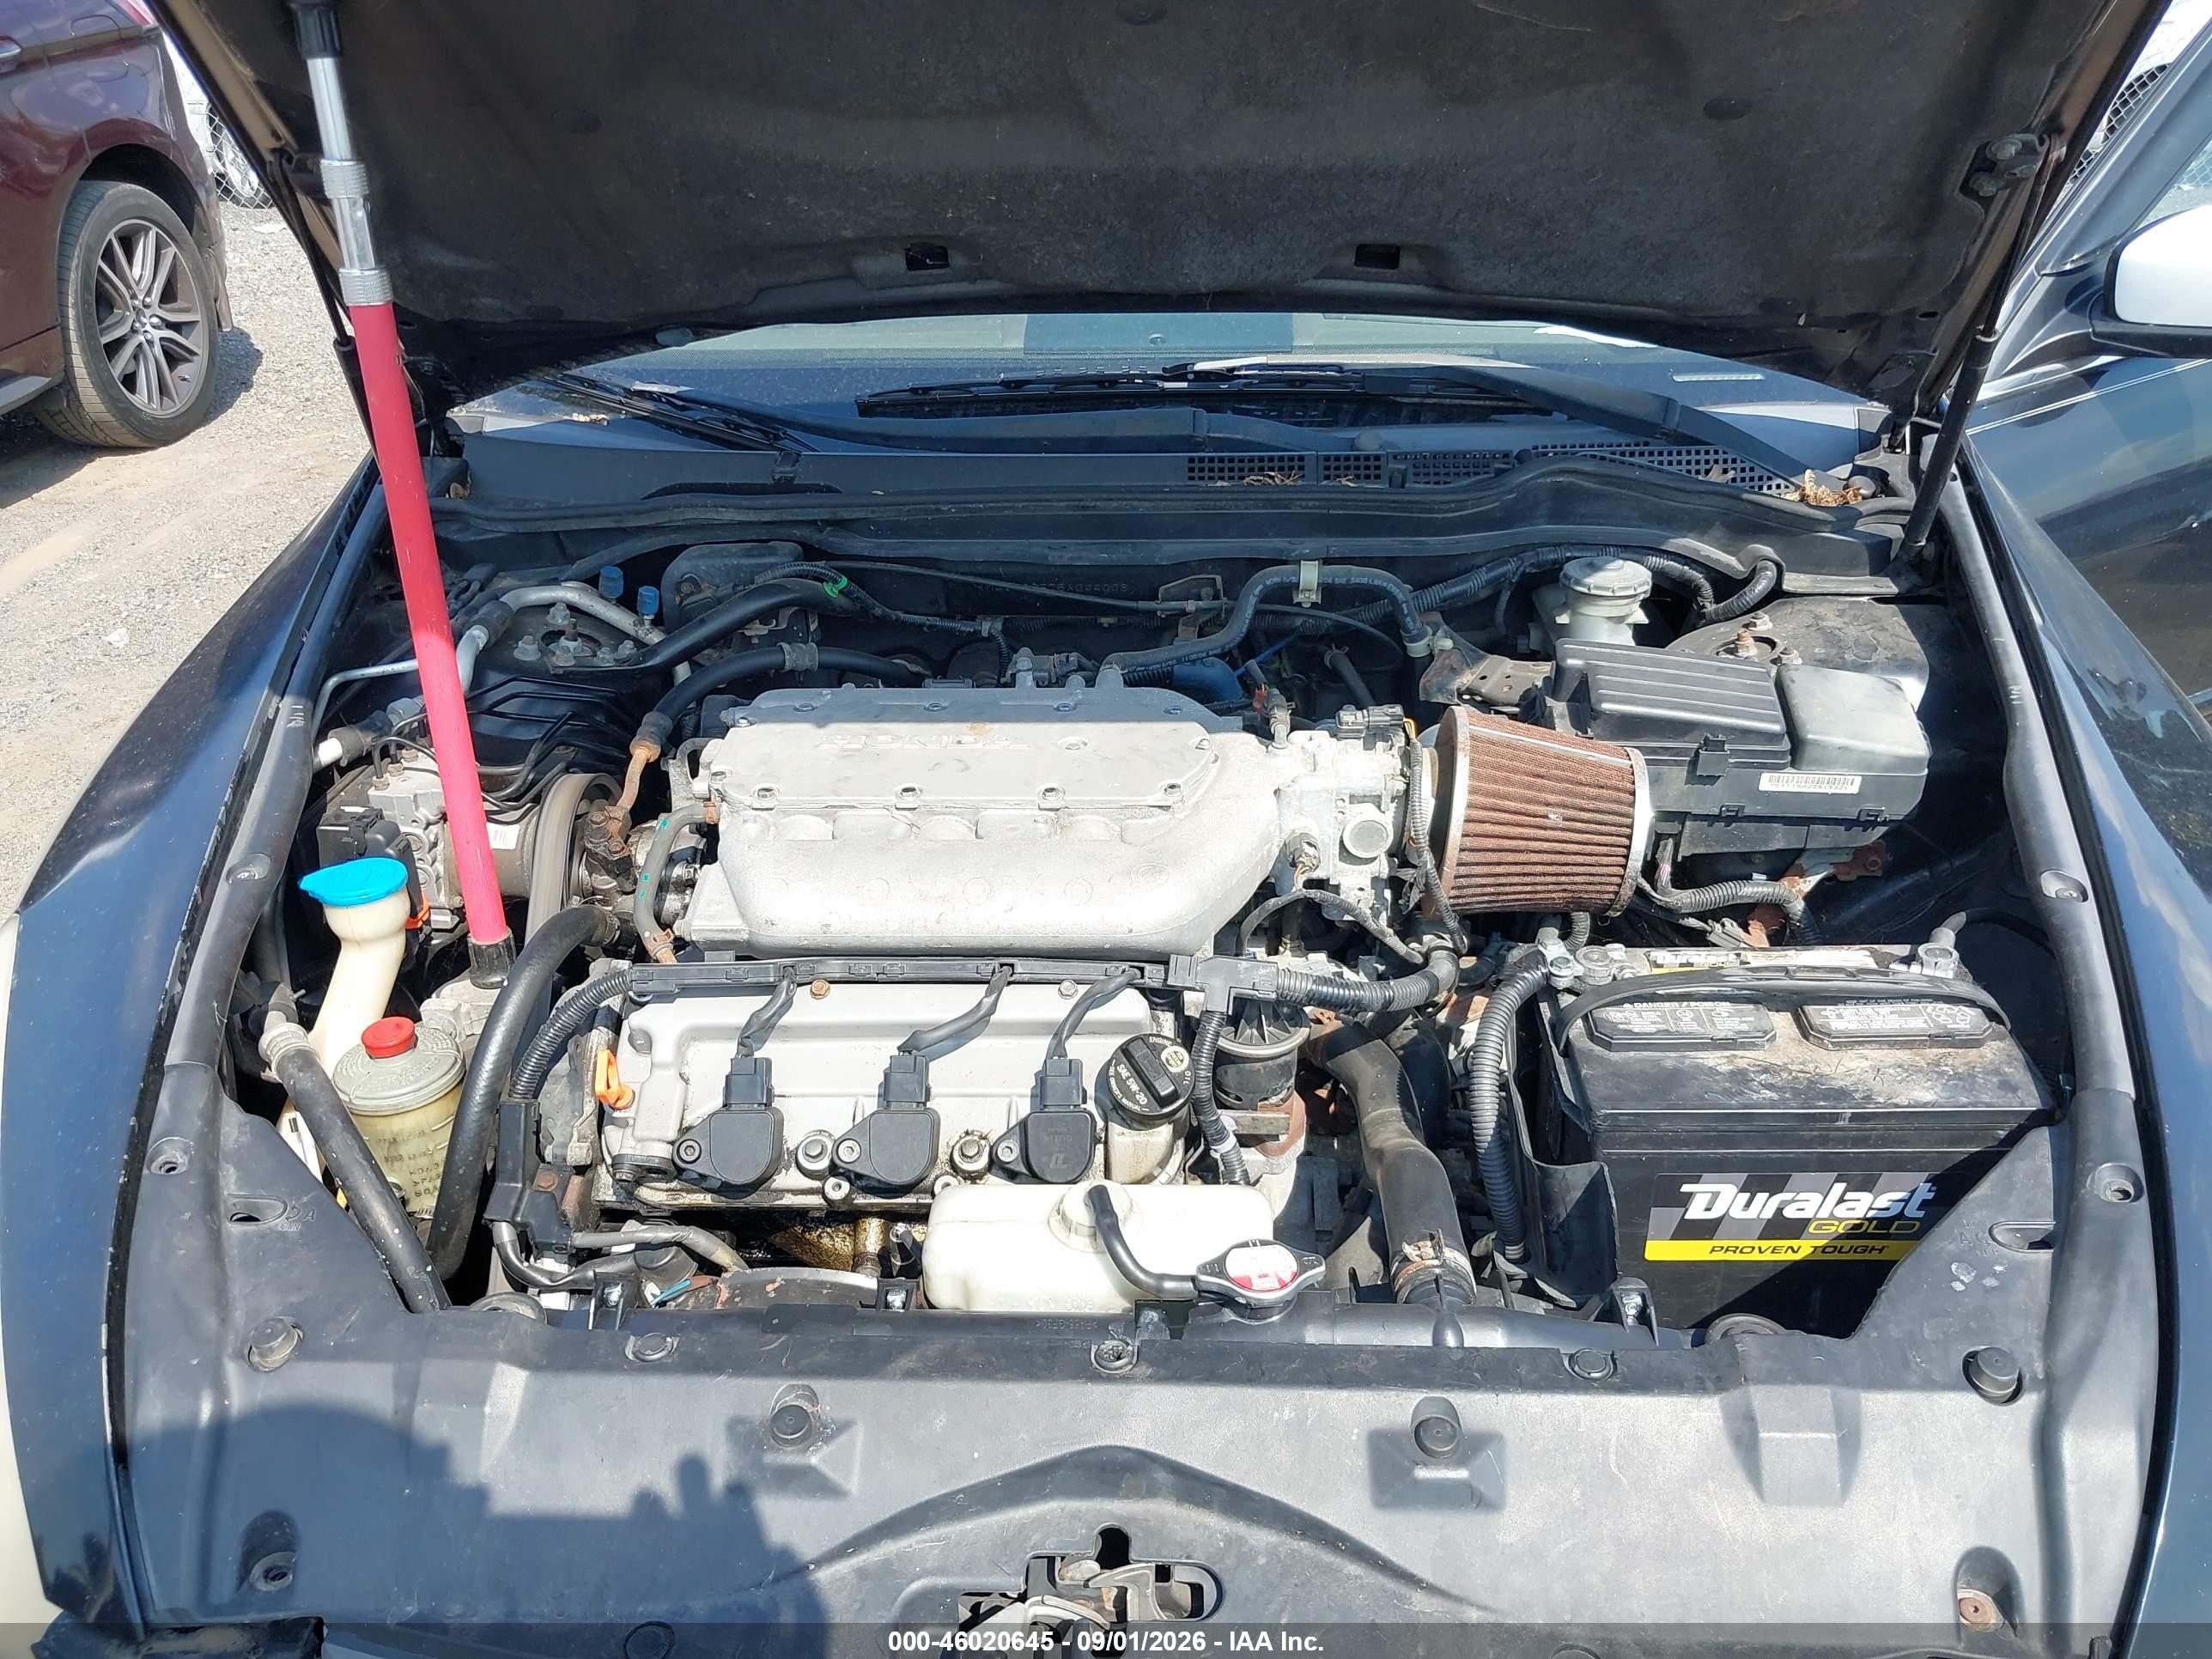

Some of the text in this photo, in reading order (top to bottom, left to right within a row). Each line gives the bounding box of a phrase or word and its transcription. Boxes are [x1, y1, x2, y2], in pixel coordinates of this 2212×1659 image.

[1149, 1036, 1191, 1085] ENGINE OIL
[1116, 1064, 1148, 1105] SAE 5W-20
[1121, 1097, 1141, 1112] MANUAL
[1680, 1182, 1937, 1219] Duralast
[1808, 1219, 1922, 1234] GOLD
[1708, 1245, 1886, 1255] PROVEN TOUGH
